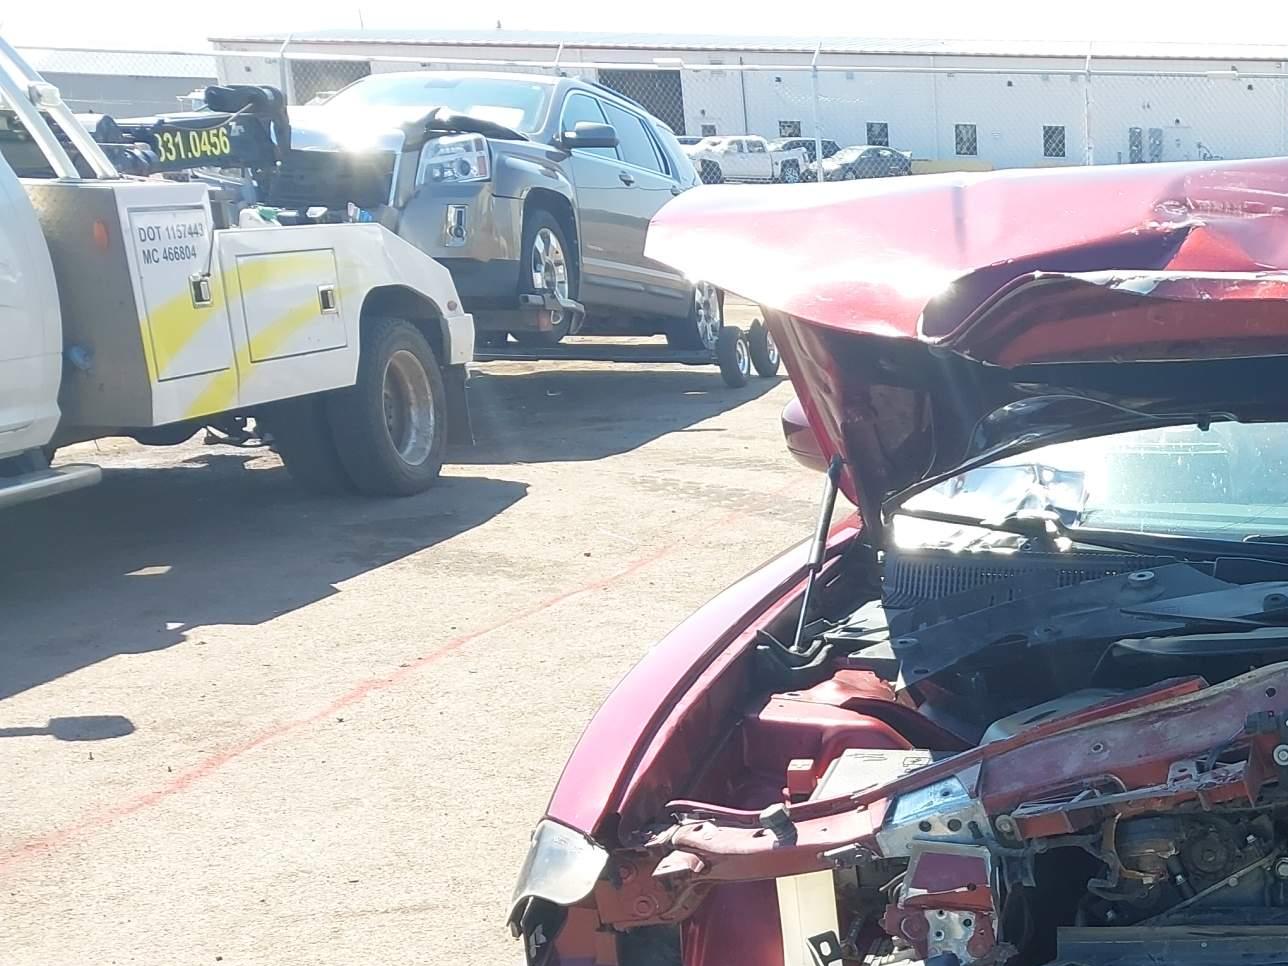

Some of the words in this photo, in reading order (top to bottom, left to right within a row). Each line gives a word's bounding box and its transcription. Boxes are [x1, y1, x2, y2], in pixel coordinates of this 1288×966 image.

[138, 226, 161, 242] DOT
[142, 248, 160, 264] MC
[162, 244, 197, 261] 466804
